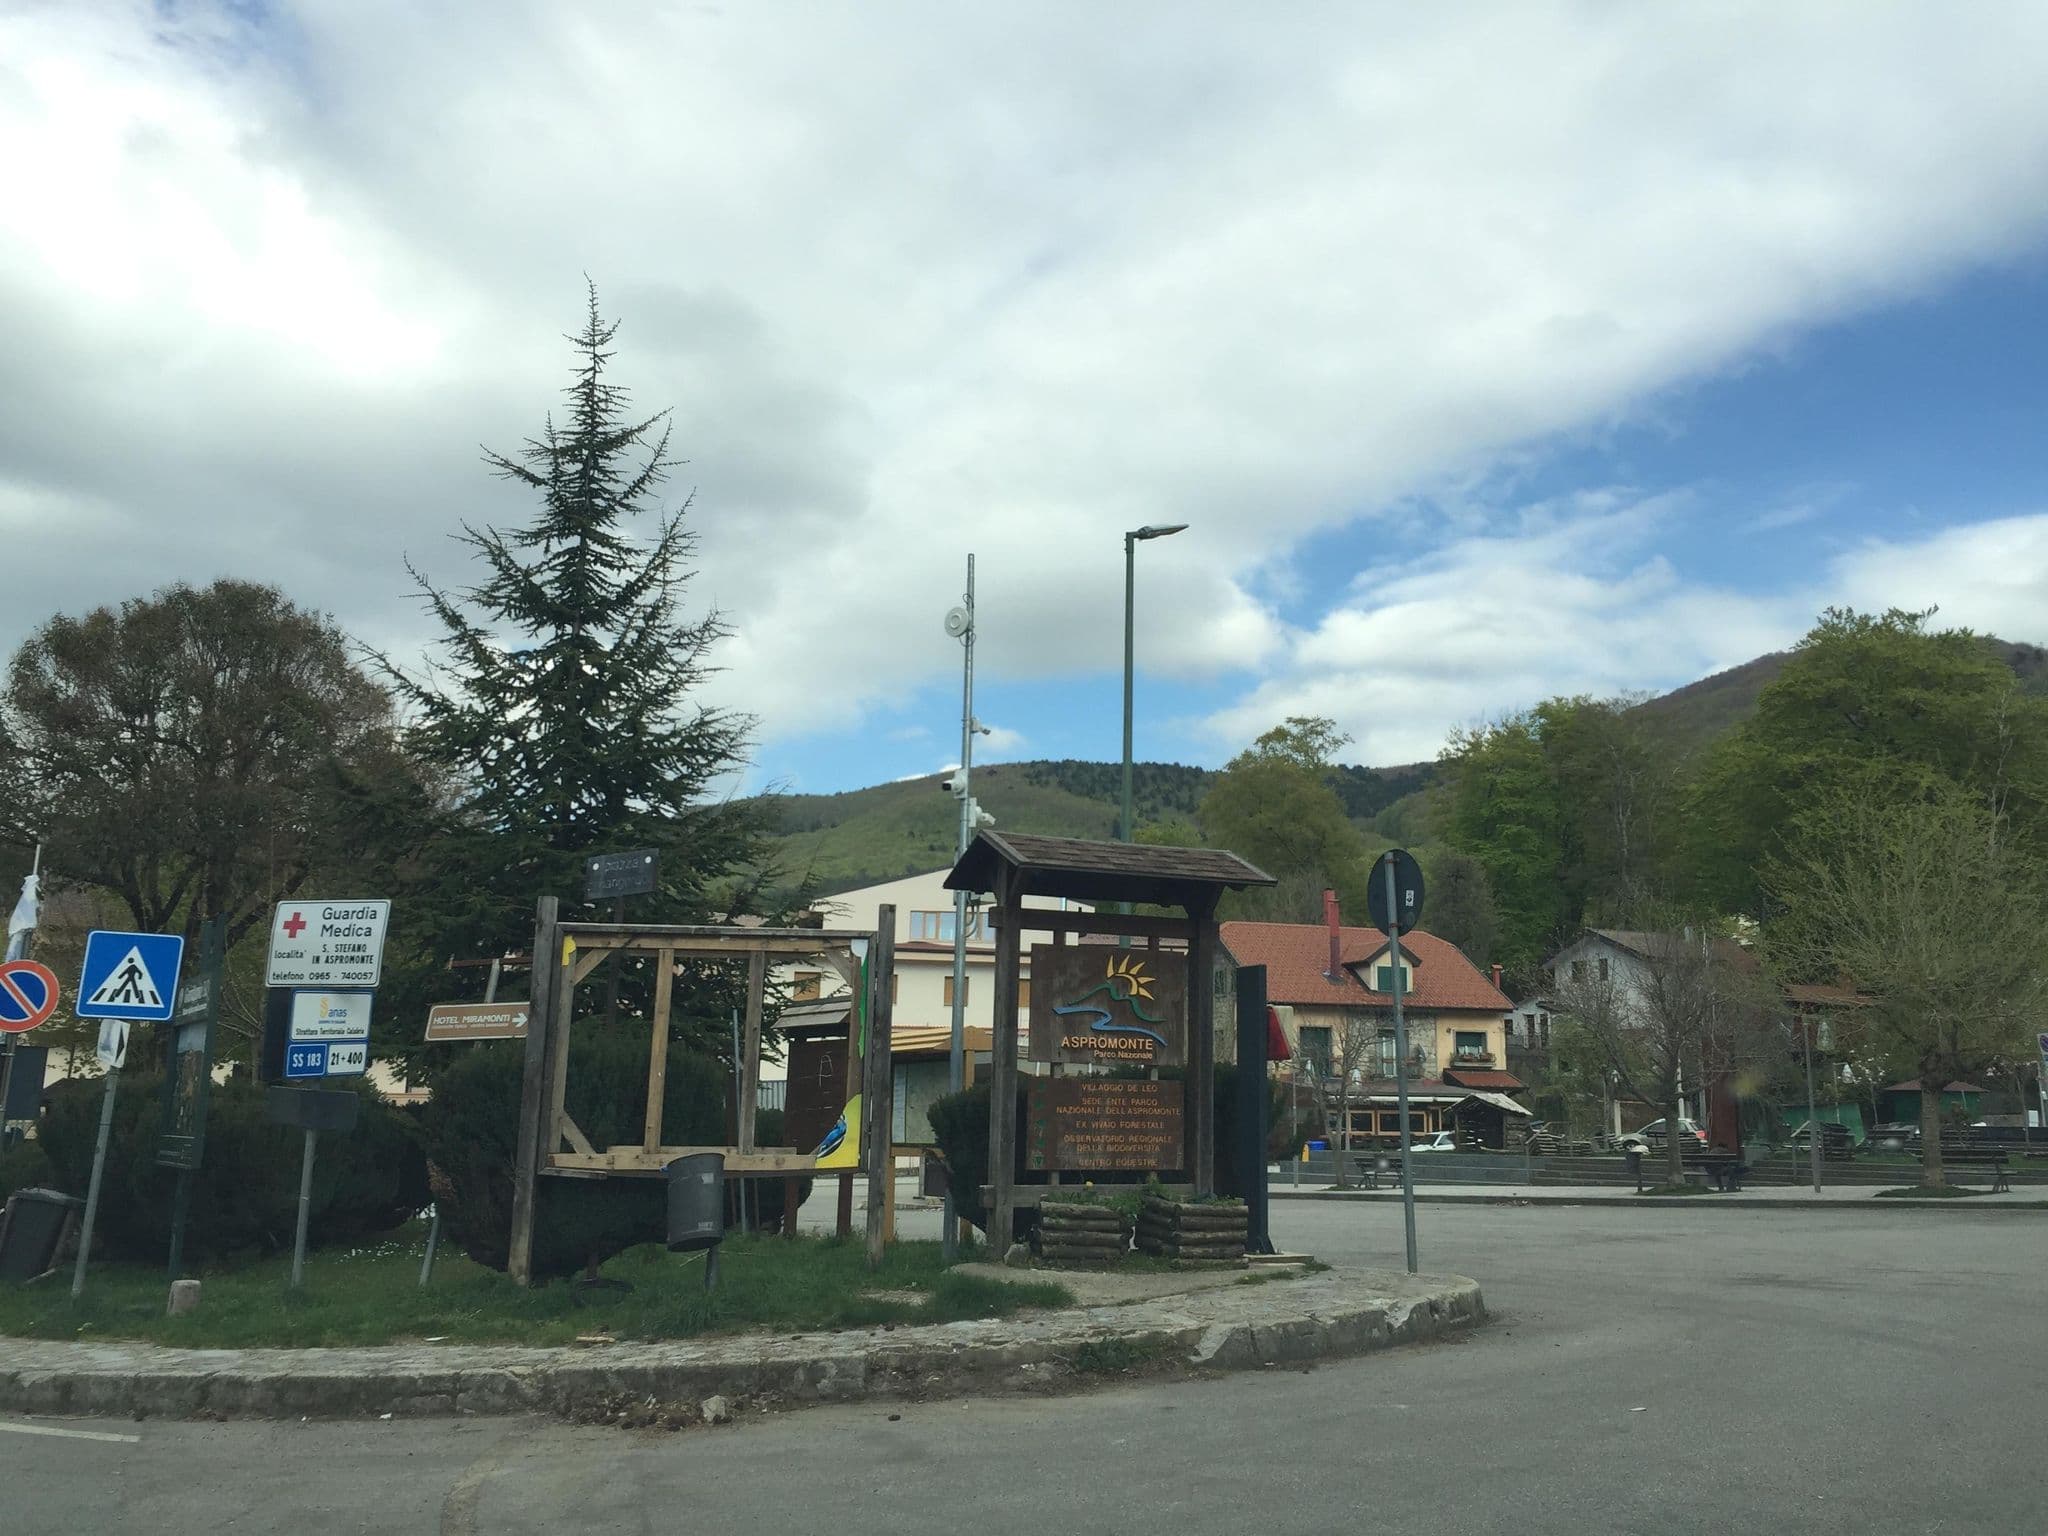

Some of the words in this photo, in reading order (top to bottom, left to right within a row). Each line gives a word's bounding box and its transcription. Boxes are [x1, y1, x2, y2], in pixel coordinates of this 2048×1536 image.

[322, 906, 377, 920] Guardia
[320, 924, 372, 937] Medica
[322, 944, 332, 953] S.
[334, 943, 367, 953] STEFANO
[312, 955, 320, 964] IN
[324, 954, 374, 964] ASPROMONTE
[272, 972, 305, 980] telefono
[309, 972, 331, 980] 0965
[341, 972, 373, 980] 740057
[327, 1007, 348, 1018] anas
[433, 1015, 460, 1024] HOTEL
[462, 1014, 511, 1024] MIRAMONTI
[1061, 1036, 1153, 1050] ASPROMONTE
[292, 1053, 304, 1068] SS
[307, 1052, 322, 1067] 183
[1093, 1050, 1116, 1059] Parco
[1117, 1050, 1153, 1060] Nazionale
[1081, 1083, 1124, 1092] VILLAGGIO
[1127, 1083, 1138, 1092] DE
[1141, 1084, 1158, 1092] LEO
[1131, 1098, 1158, 1106] PARCO
[1056, 1105, 1101, 1115] NAZIONALE
[1075, 1120, 1087, 1129] EX
[1091, 1120, 1117, 1129] VIVAIO
[1119, 1120, 1164, 1129] FORESTALE
[1063, 1134, 1125, 1143] OSSERVATORIO
[1128, 1135, 1173, 1144] REGIONALE
